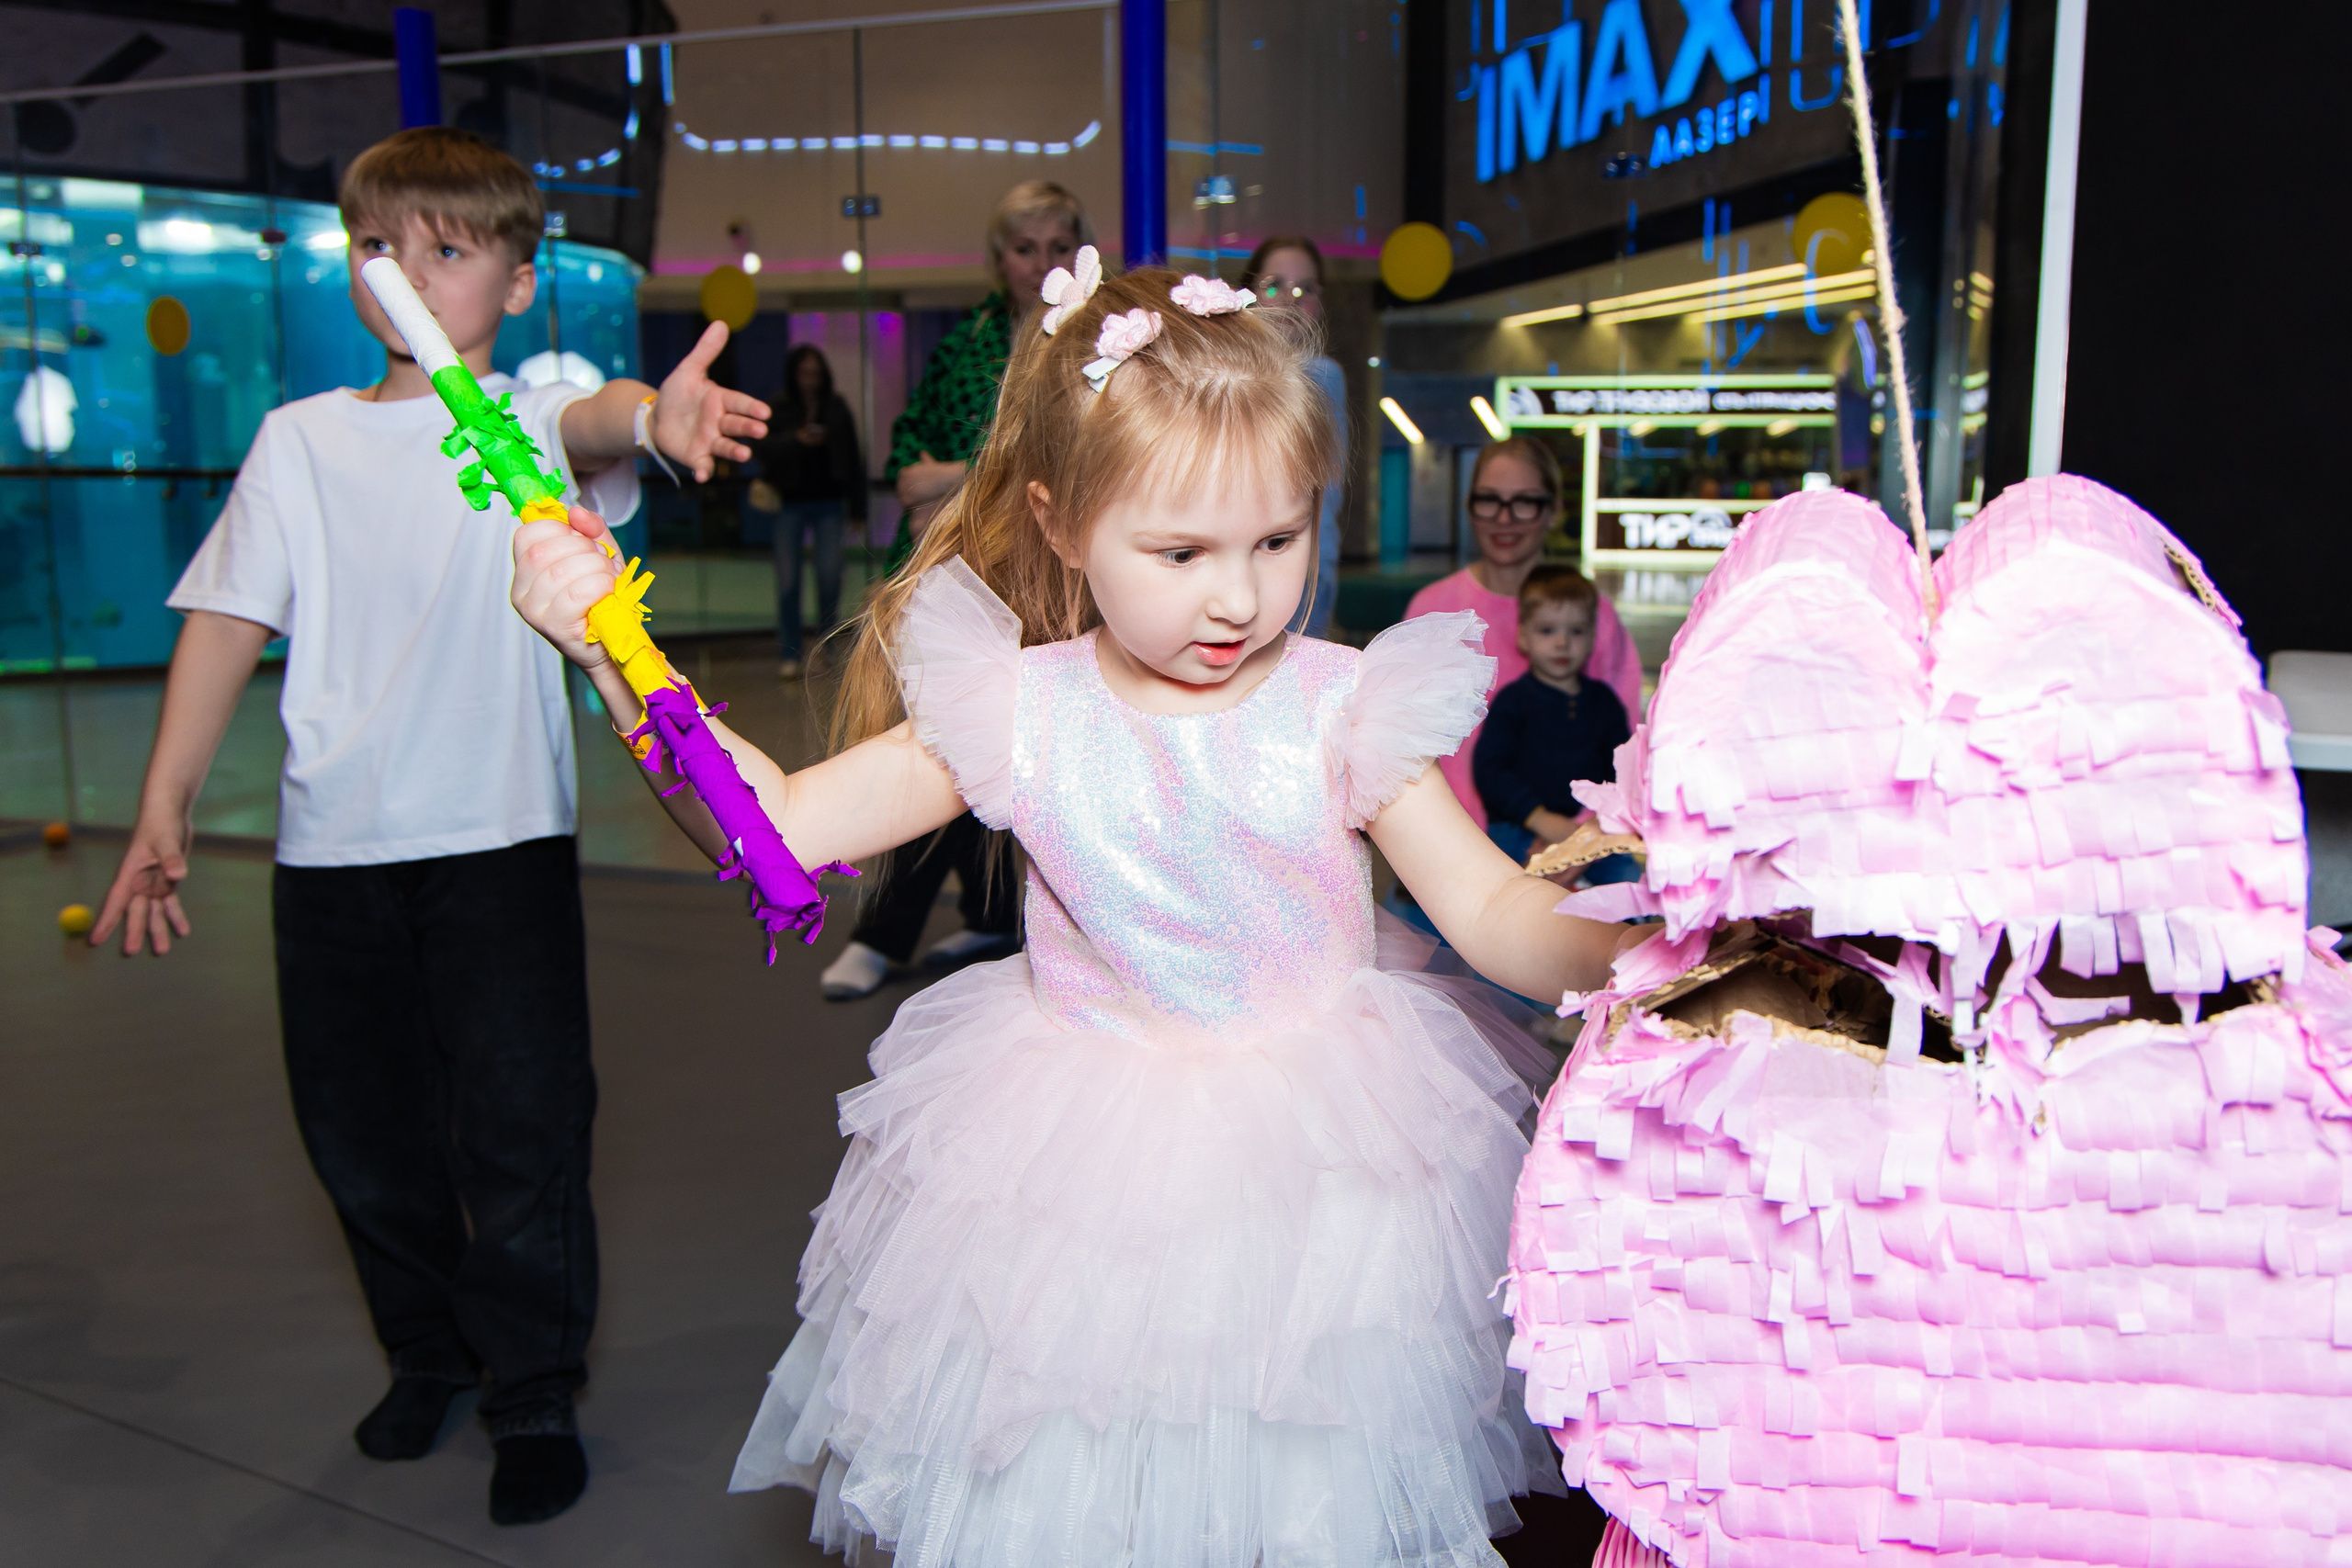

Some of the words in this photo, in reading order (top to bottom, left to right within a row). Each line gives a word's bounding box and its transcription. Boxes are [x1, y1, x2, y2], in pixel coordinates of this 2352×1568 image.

[1476, 0, 1758, 183] IMAX
[1648, 90, 1759, 169] ЛАЗЕР
[1618, 513, 1690, 549] ТИР
